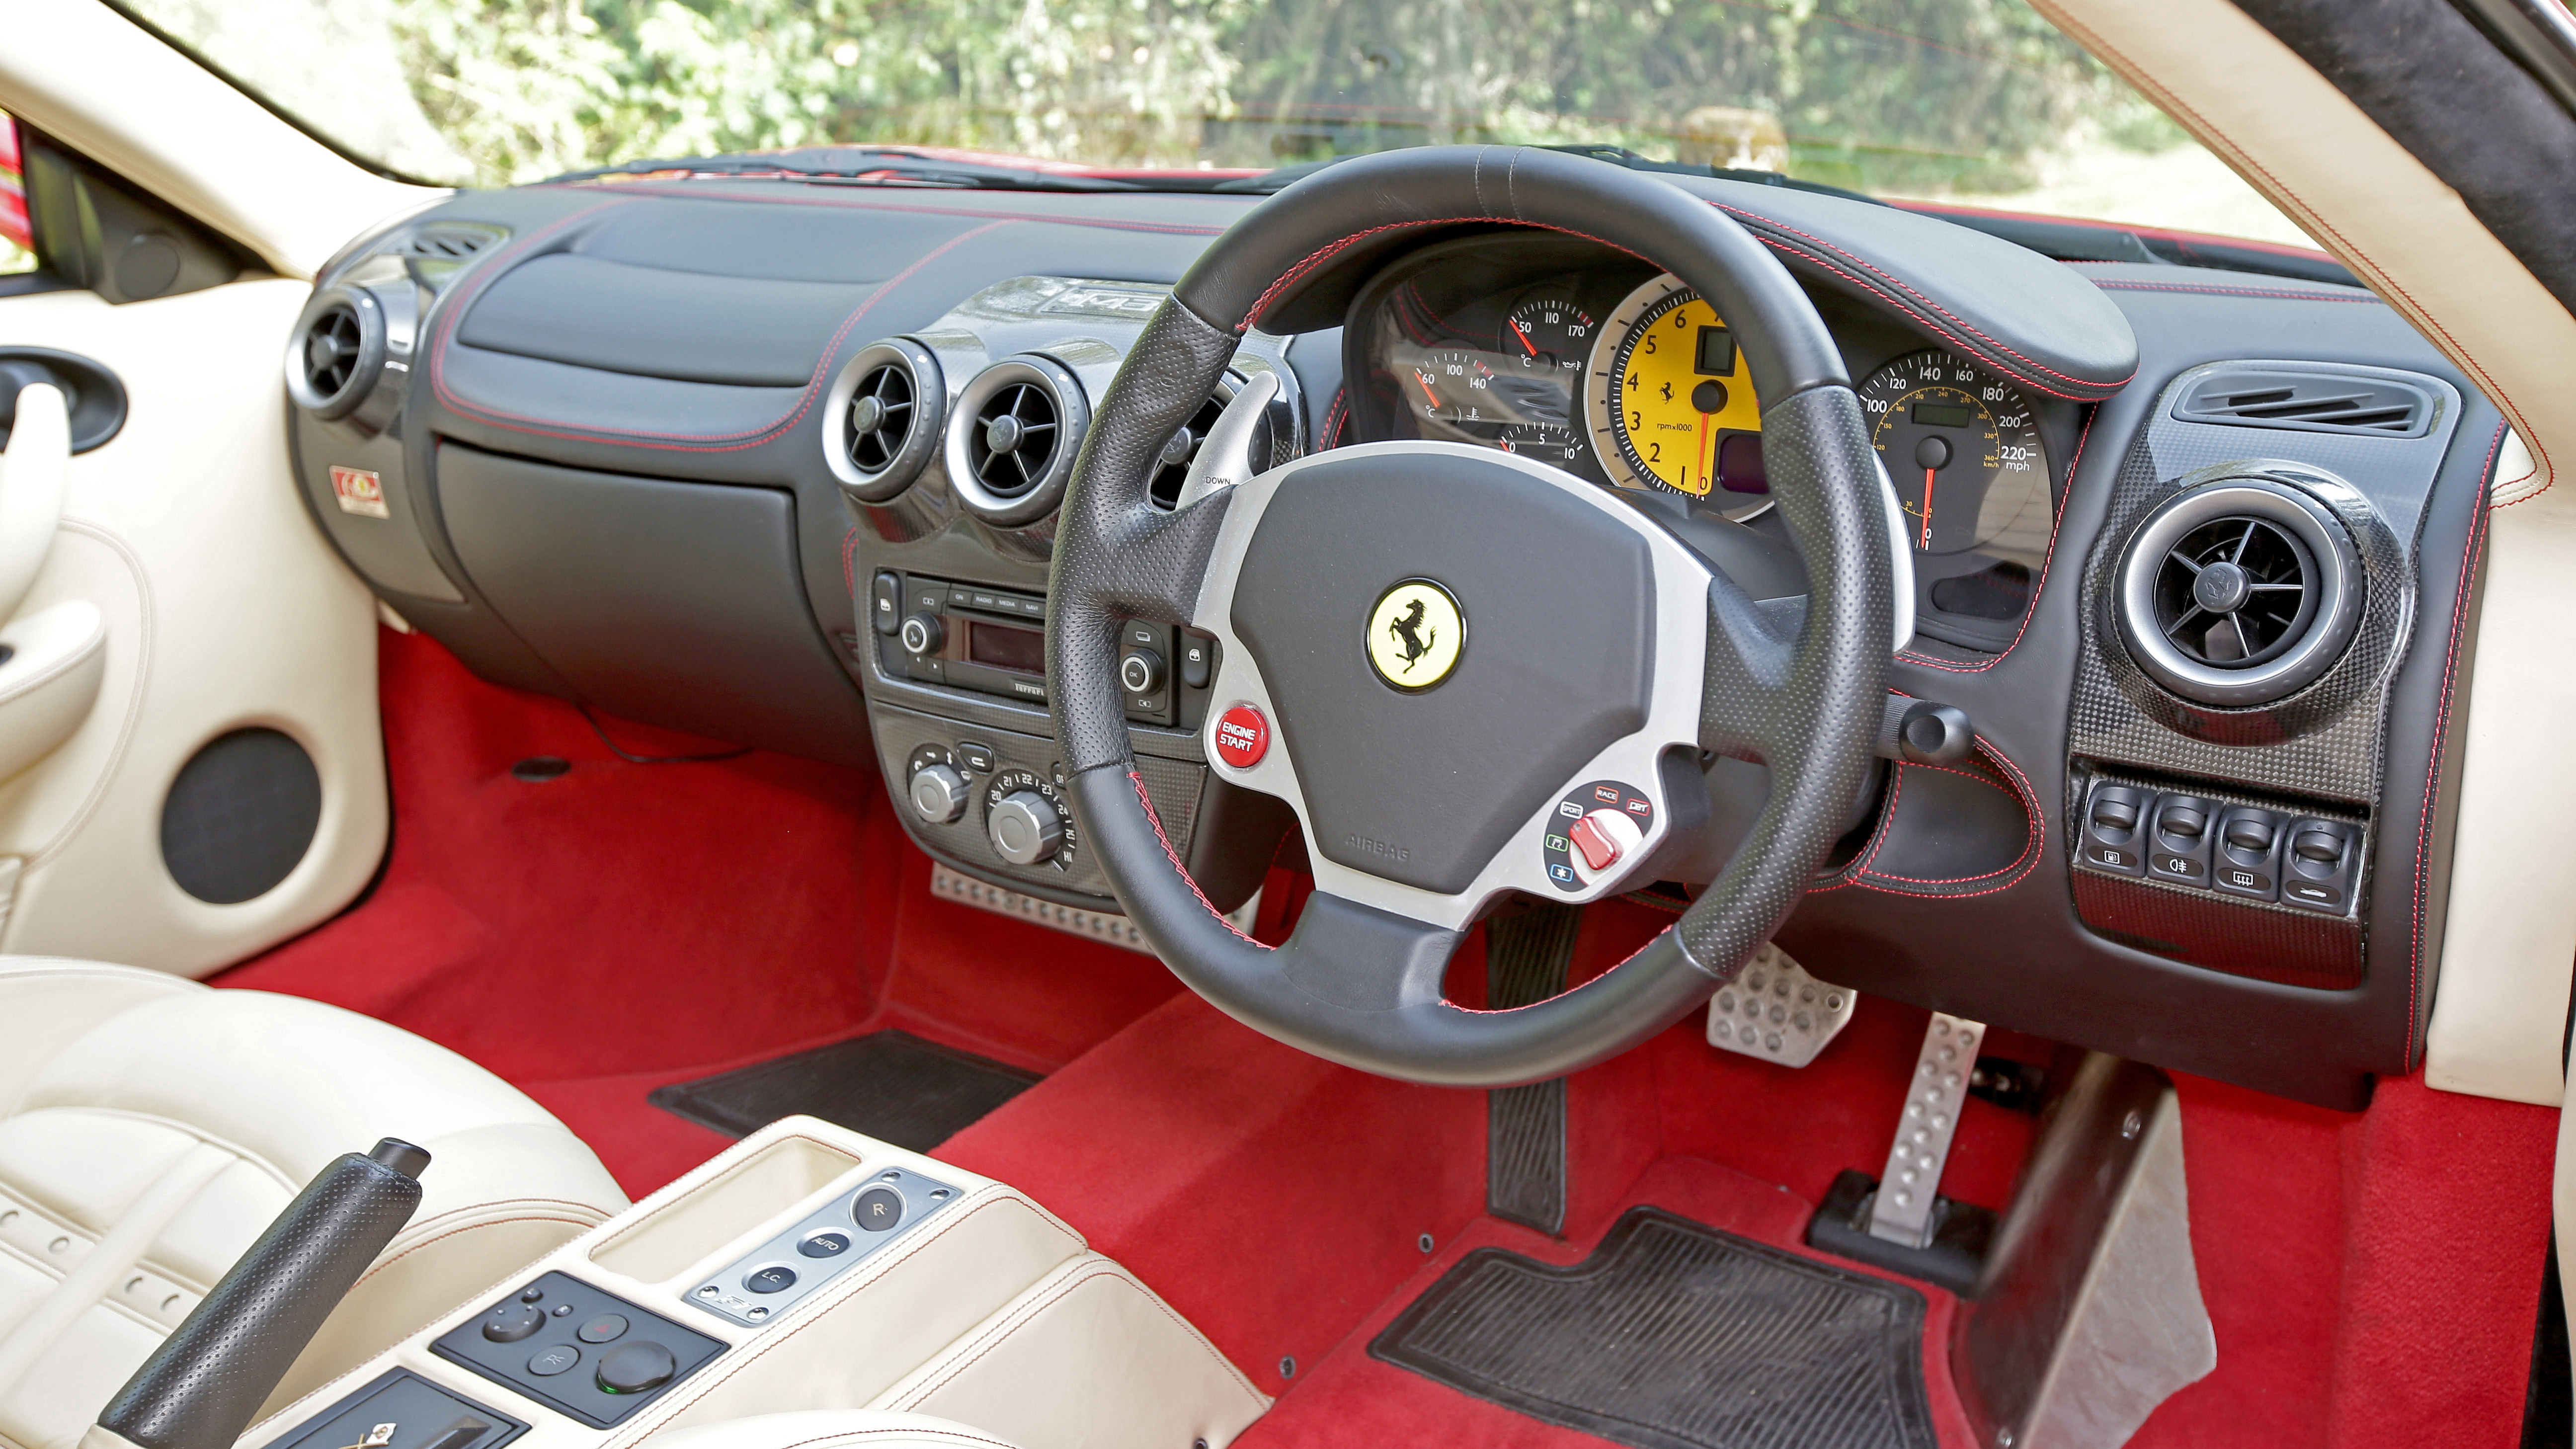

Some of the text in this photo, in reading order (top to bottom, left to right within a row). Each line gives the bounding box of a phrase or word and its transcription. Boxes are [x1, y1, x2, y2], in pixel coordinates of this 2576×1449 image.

[1545, 312, 1559, 323] 110
[1674, 309, 1686, 328] 6
[1519, 321, 1532, 333] 50
[1568, 324, 1585, 337] 170
[1645, 335, 1657, 354] 5
[1447, 364, 1463, 376] 100
[1920, 366, 1941, 381] 140
[1956, 369, 1973, 382] 160
[1422, 373, 1435, 384] 60
[1469, 377, 1486, 389] 140
[1626, 372, 1639, 391] 4
[1890, 378, 1907, 390] 120
[1983, 387, 2004, 402] 180
[1867, 399, 1888, 413] 100
[1630, 410, 1641, 431] 3
[1999, 416, 2021, 428] 200
[1538, 433, 1545, 445] 5
[1509, 442, 1516, 453] 0
[1564, 447, 1576, 460] 10
[1649, 442, 1661, 463] 2
[2000, 445, 2027, 461] 220
[2006, 460, 2030, 473] mph
[1206, 476, 1231, 485] DOWN
[1700, 477, 1708, 490] 0
[1925, 528, 1932, 540] 0
[1222, 722, 1257, 740] ENGINE
[1219, 733, 1253, 752] START
[1003, 776, 1012, 787] 21
[1022, 773, 1033, 785] 22
[991, 790, 1001, 801] 20
[1042, 784, 1052, 795] 23
[1598, 790, 1618, 800] RACE
[1057, 804, 1068, 816] 24
[1065, 828, 1075, 840] 25
[1345, 834, 1409, 862] AIRBAG
[1063, 851, 1072, 863] HI
[873, 1203, 885, 1216] R
[811, 1237, 839, 1251] AUTO
